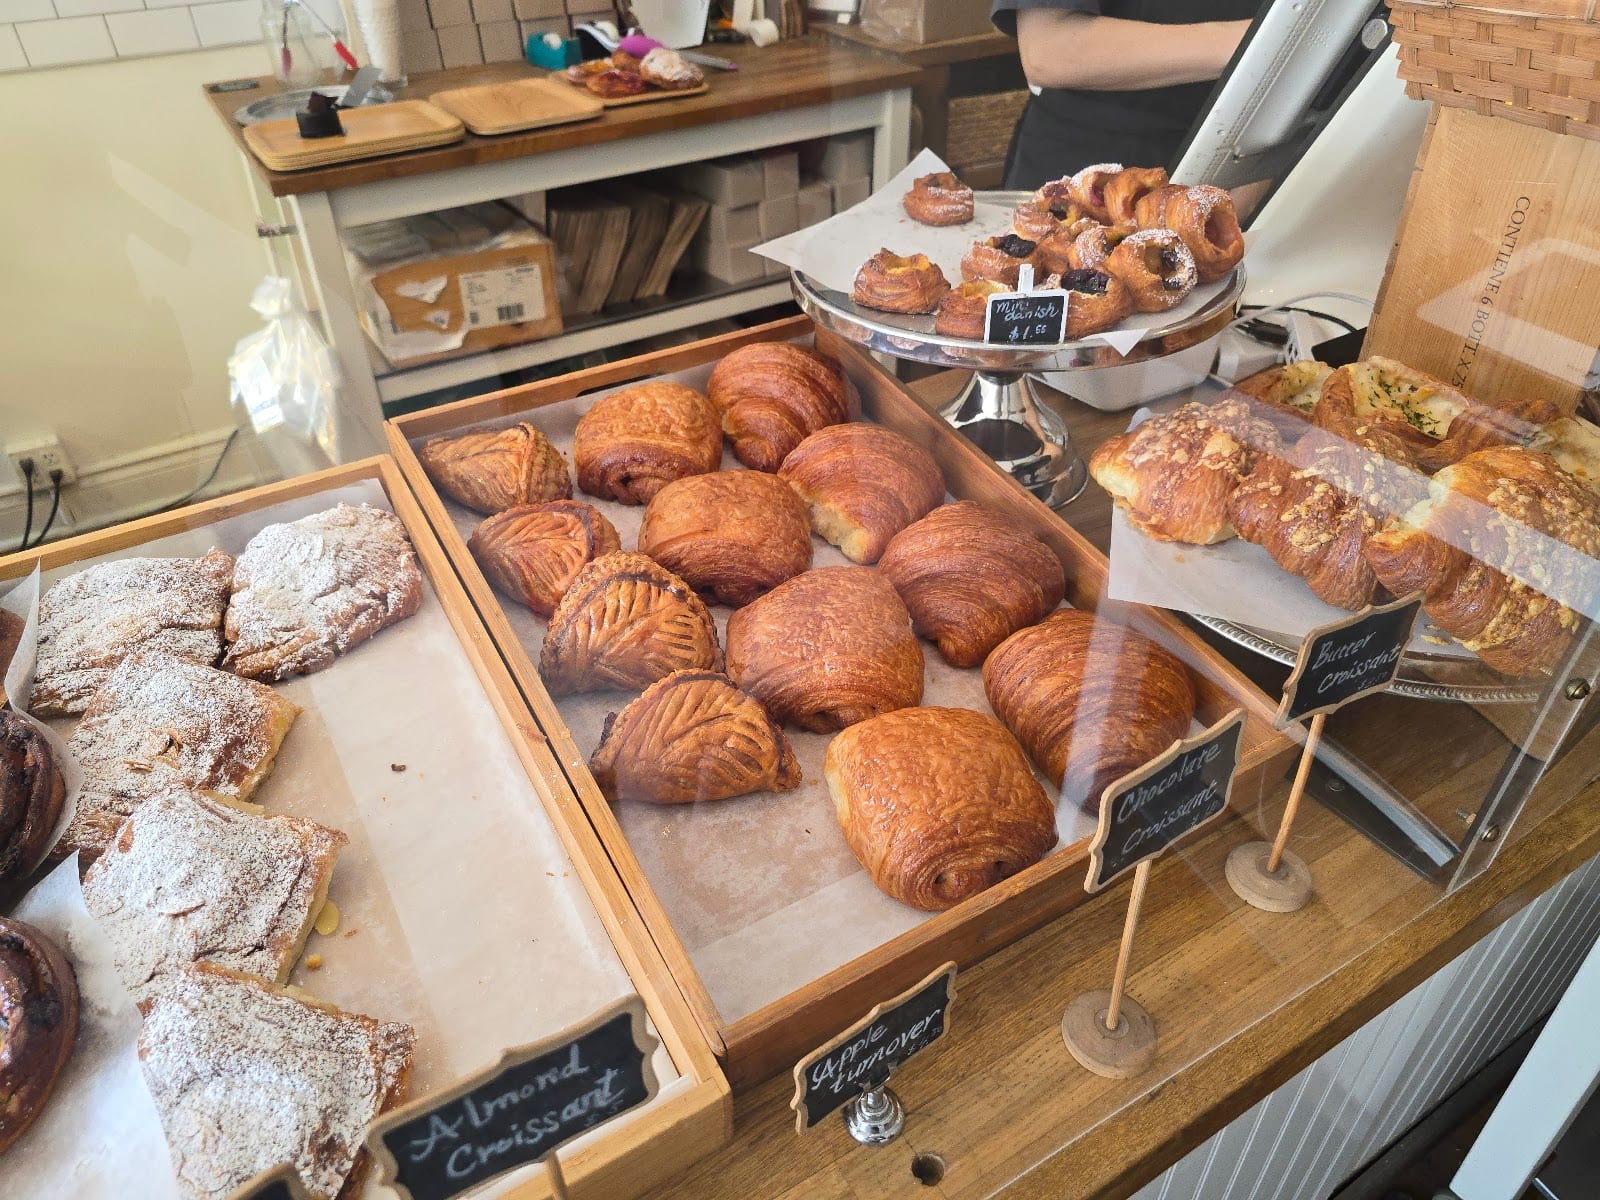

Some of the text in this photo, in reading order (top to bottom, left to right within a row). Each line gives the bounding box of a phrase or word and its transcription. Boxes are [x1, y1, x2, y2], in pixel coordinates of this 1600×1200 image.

[1485, 196, 1531, 295] CONTIENE
[1004, 302, 1060, 321] danish
[1480, 296, 1493, 305] 6
[1311, 631, 1377, 671] Butter
[1116, 743, 1222, 824] Chocolate
[810, 1024, 888, 1091] Apple
[829, 1008, 941, 1094] turnover
[409, 1042, 589, 1162] Almond
[446, 1067, 626, 1178] Croissant
